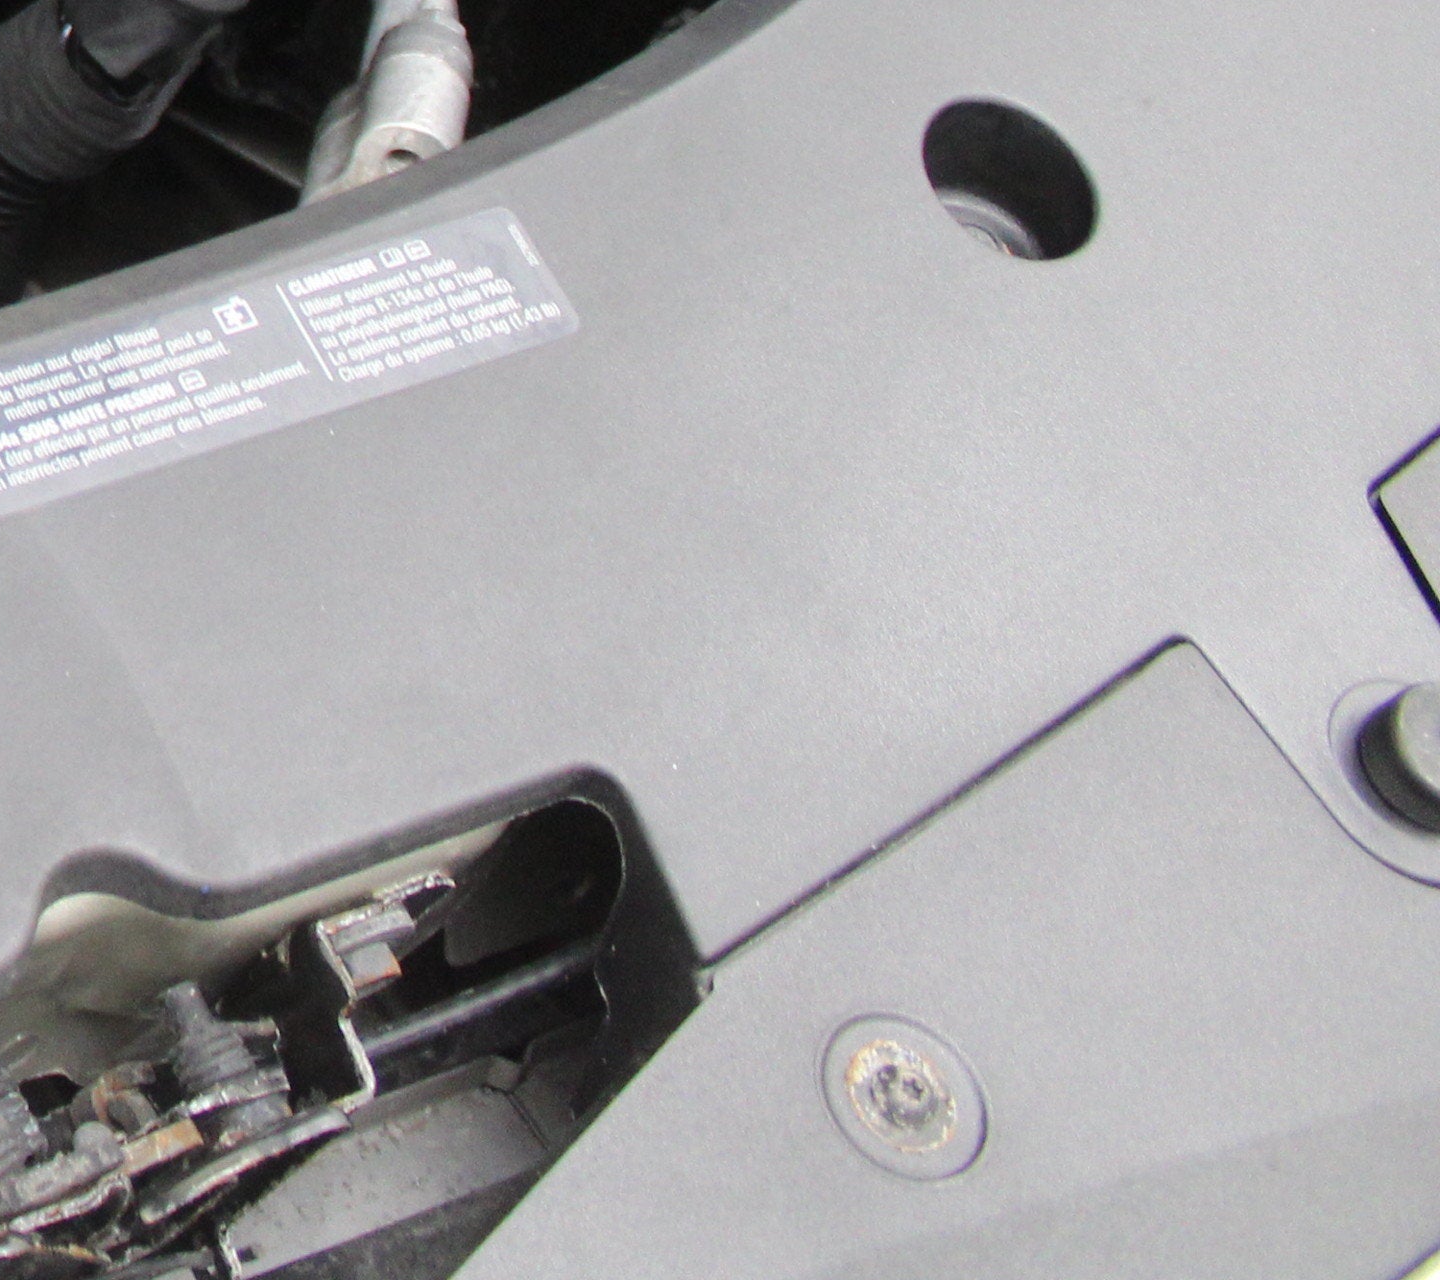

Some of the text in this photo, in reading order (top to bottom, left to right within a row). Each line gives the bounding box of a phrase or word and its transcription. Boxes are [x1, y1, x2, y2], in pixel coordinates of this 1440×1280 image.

[45, 354, 70, 371] aux
[77, 364, 98, 379] Le
[165, 332, 196, 355] peut
[195, 329, 212, 343] se
[4, 398, 47, 420] mettre
[58, 380, 105, 403] tourner
[107, 369, 139, 388] sans
[19, 418, 59, 442] SOUS
[58, 403, 106, 429] HAUTE
[106, 382, 174, 414] PRESSION
[87, 424, 109, 442] par
[110, 418, 130, 433] un
[130, 397, 193, 428] personnel
[80, 436, 132, 465] peuvent
[132, 424, 174, 446] causer
[176, 415, 202, 432] des
